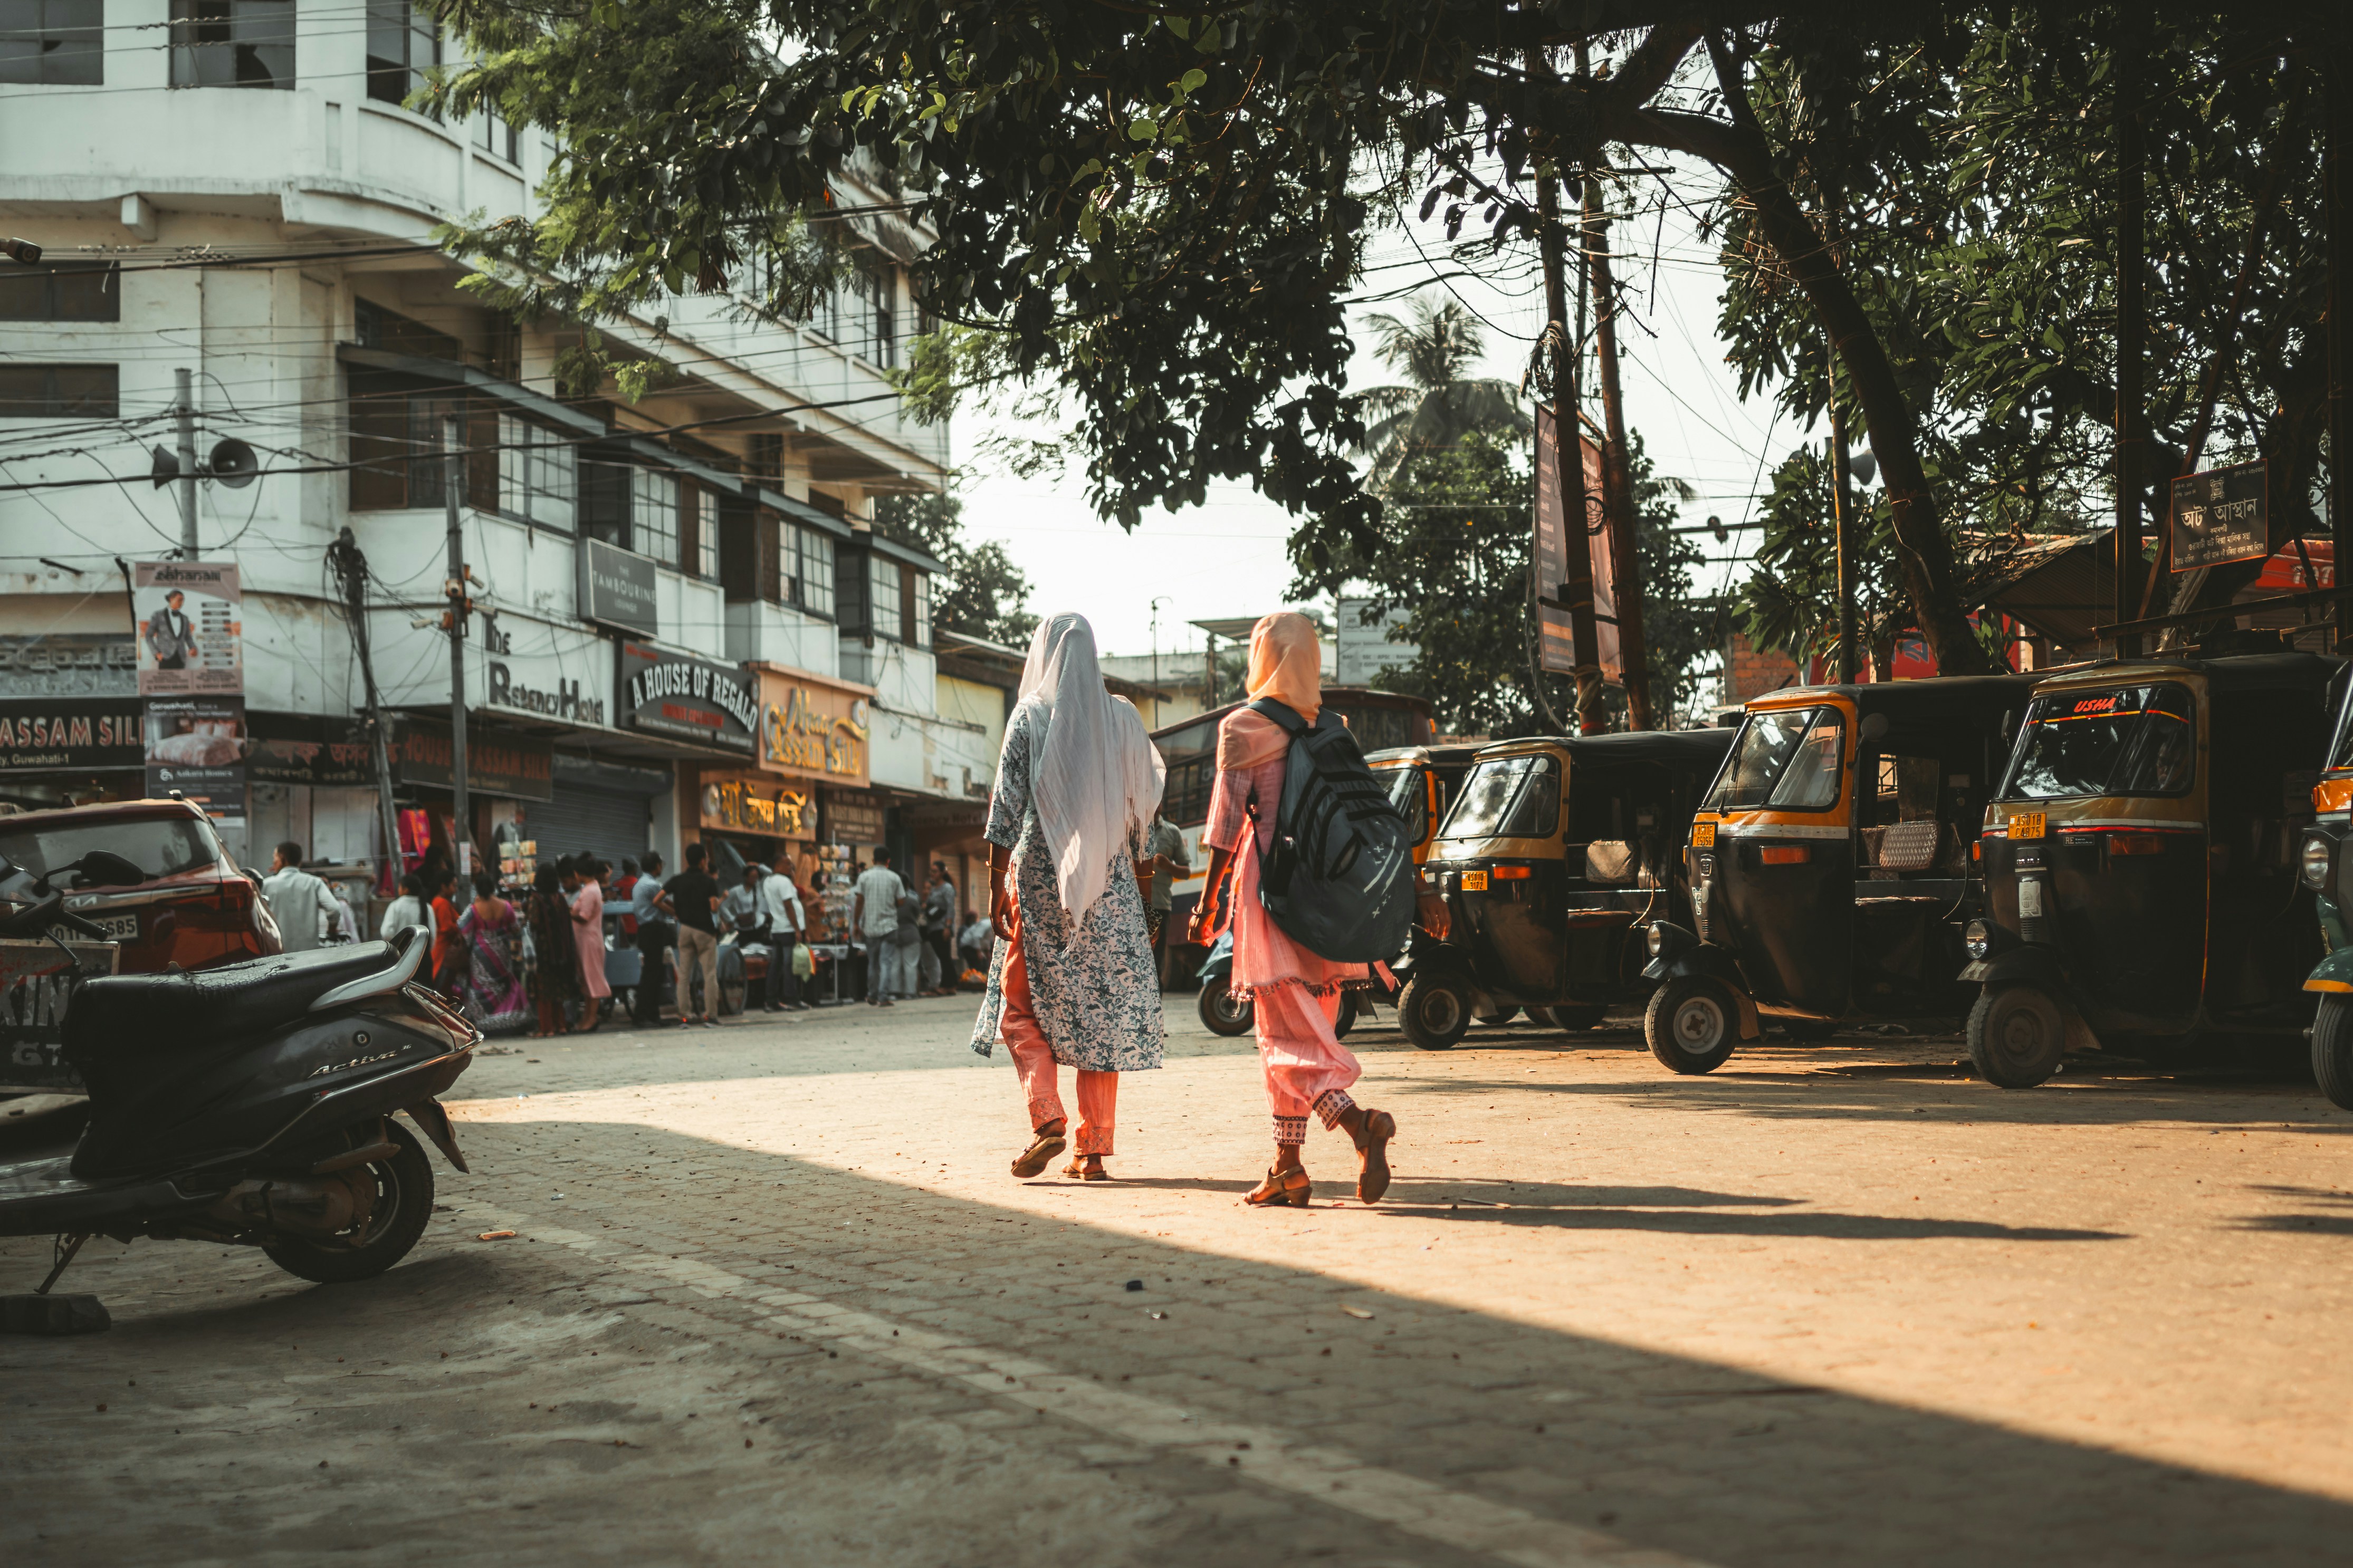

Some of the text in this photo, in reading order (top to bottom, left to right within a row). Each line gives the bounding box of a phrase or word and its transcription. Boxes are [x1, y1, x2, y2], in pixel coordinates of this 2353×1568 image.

[2213, 498, 2258, 522] আস্থান
[592, 570, 656, 606] TAMBOURINE
[633, 676, 644, 710] A
[644, 662, 691, 701] HOUSE
[694, 665, 710, 699] OF
[712, 671, 758, 734] REGALO
[2073, 697, 2117, 713] USHA
[0, 716, 93, 748] ASSAM
[763, 703, 826, 770] Assam
[12, 753, 70, 765] Guwahati-1
[307, 1050, 398, 1079] Activa
